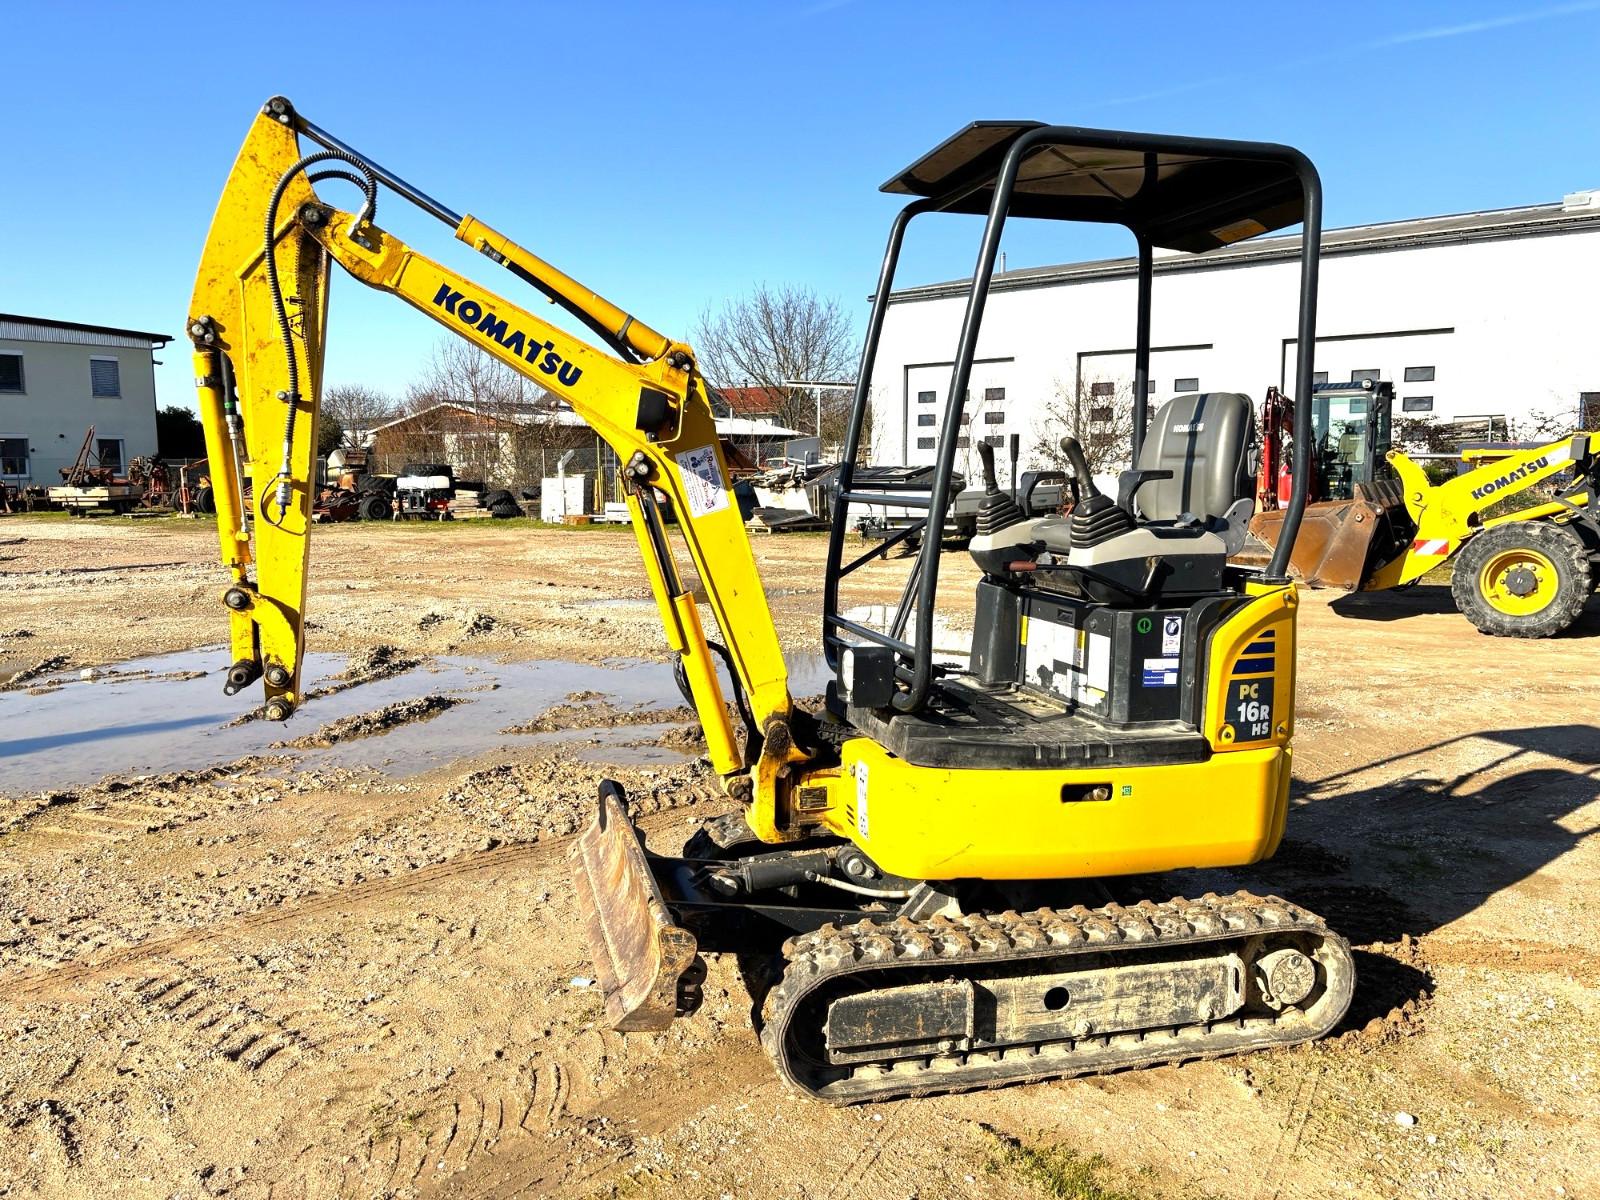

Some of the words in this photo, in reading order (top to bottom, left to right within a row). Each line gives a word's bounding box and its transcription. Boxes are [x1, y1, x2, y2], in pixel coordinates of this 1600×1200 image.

[433, 283, 583, 387] KOMATSU
[1471, 456, 1549, 500] KOMATSU
[1240, 683, 1259, 700] PC
[1237, 701, 1270, 723] 16R
[1251, 722, 1269, 736] HS
